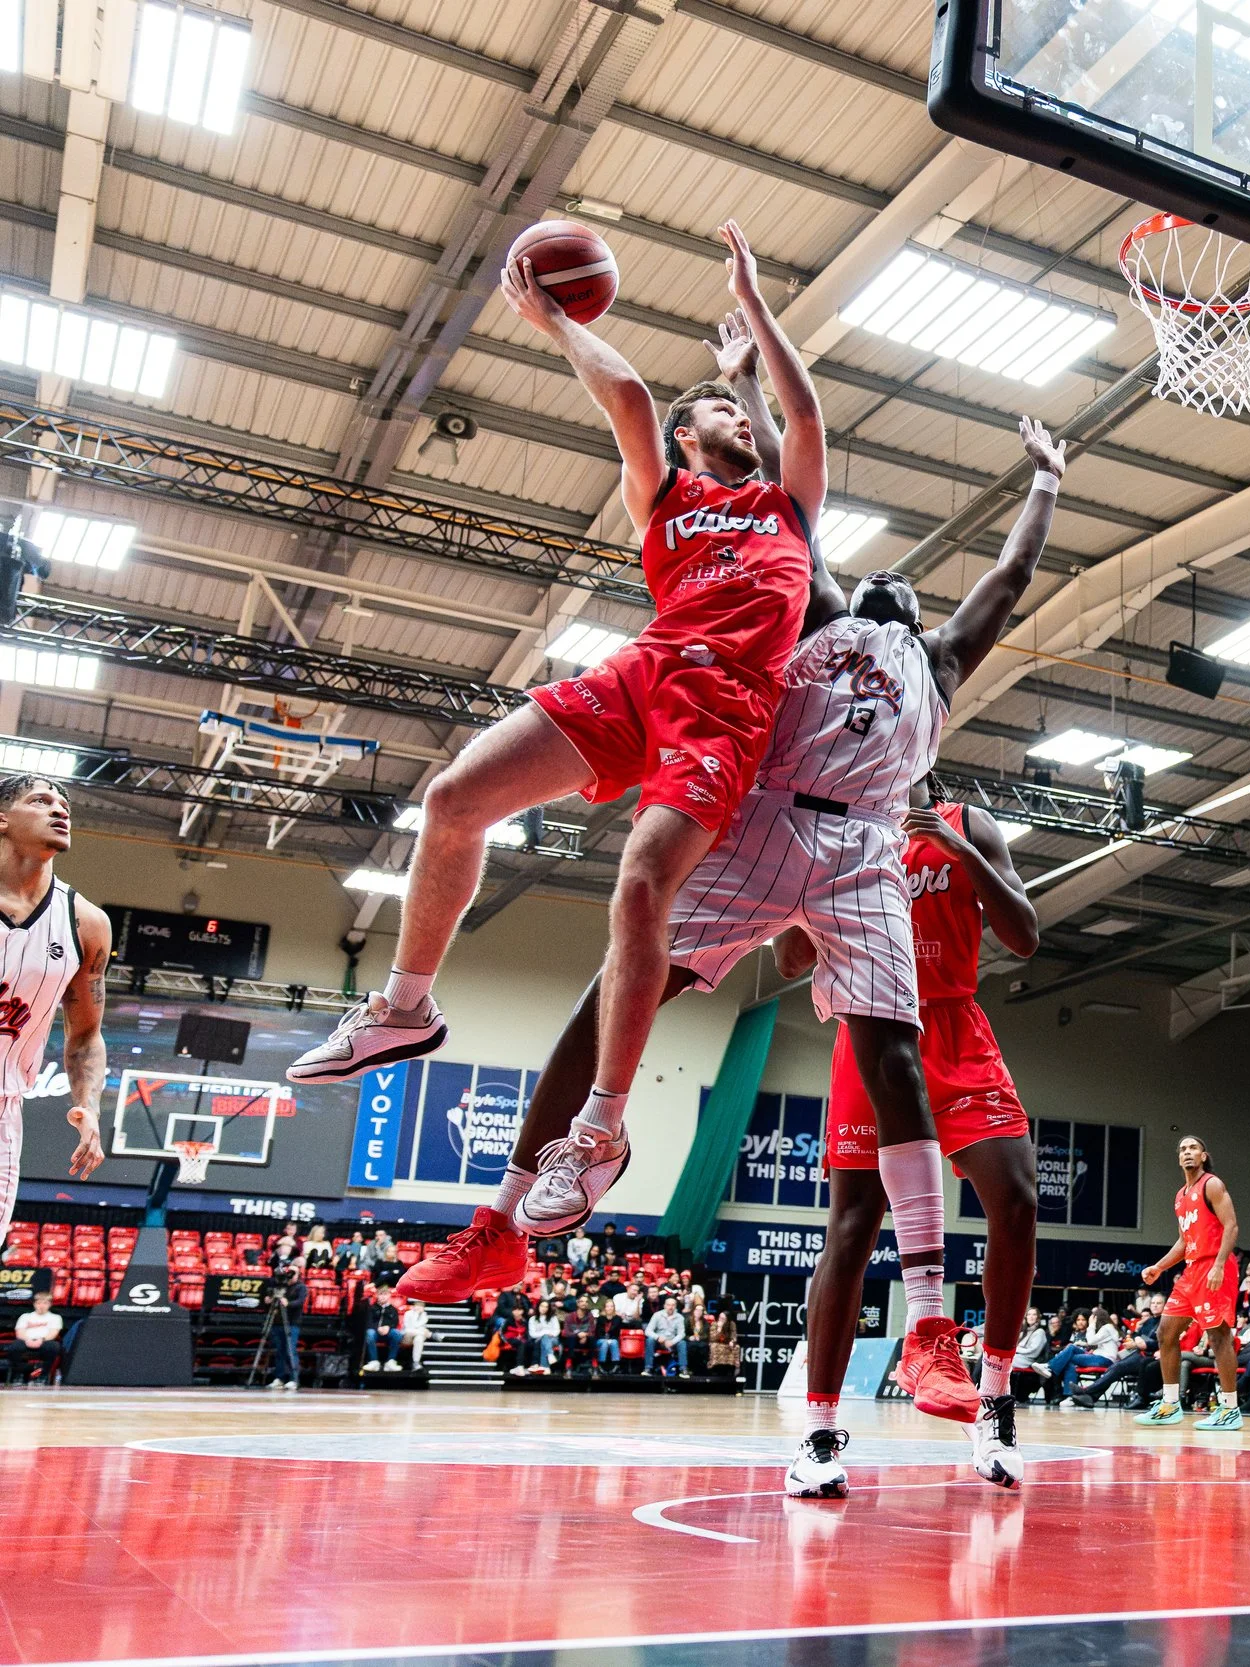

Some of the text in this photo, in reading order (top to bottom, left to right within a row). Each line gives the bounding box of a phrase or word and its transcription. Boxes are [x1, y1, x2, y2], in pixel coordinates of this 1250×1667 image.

[665, 500, 780, 551] Riders
[843, 704, 876, 737] 13
[686, 781, 717, 803] Reebok
[137, 924, 172, 939] HOME
[207, 919, 218, 933] 6
[188, 930, 232, 946] GUESTS
[364, 1063, 395, 1182] VOTEL
[851, 1125, 877, 1136] VER
[472, 1140, 511, 1156] PRIX
[746, 1162, 787, 1181] THIS
[789, 1165, 806, 1182] IS
[1038, 1184, 1067, 1197] PRIX
[229, 1197, 316, 1222] THIS IS
[757, 1229, 824, 1251] THIS IS
[1088, 1258, 1148, 1276] BoyleSp
[0, 1269, 35, 1284] 967
[220, 1278, 264, 1293] 1967
